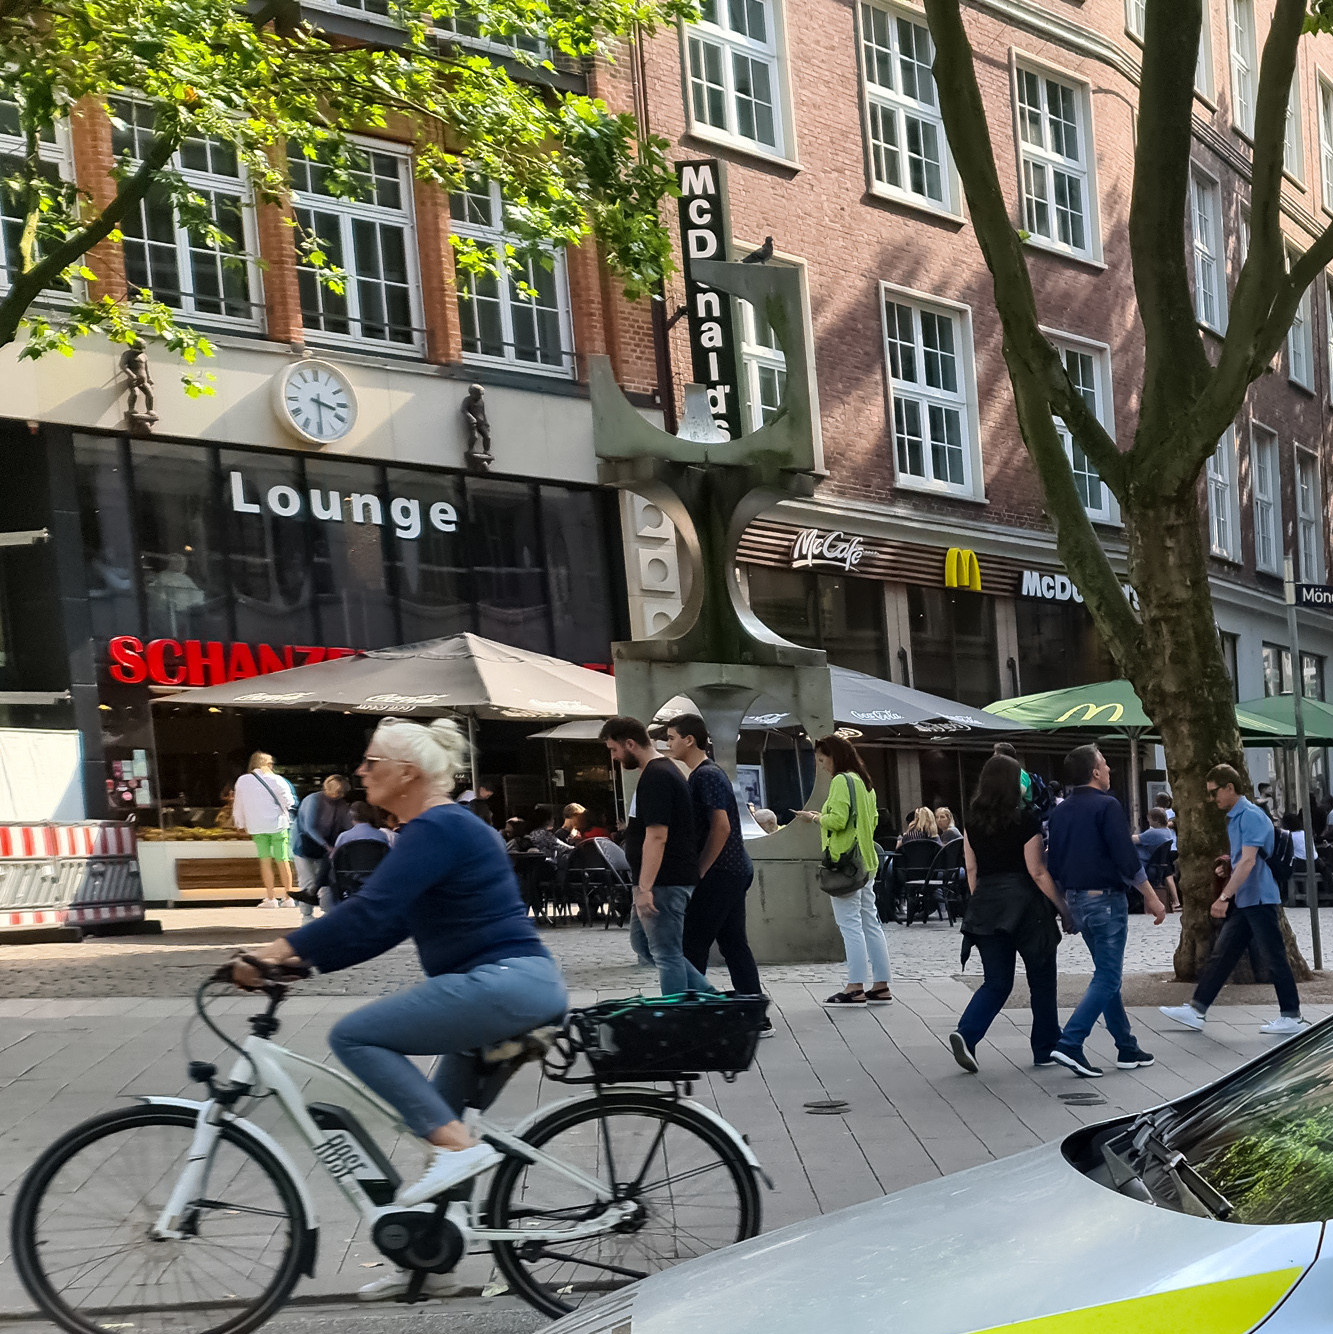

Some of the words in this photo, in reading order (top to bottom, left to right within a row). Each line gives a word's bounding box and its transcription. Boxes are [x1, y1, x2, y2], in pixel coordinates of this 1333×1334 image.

[681, 165, 731, 442] McDnald's
[230, 471, 458, 539] Lounge
[108, 635, 366, 685] SCHANZ
